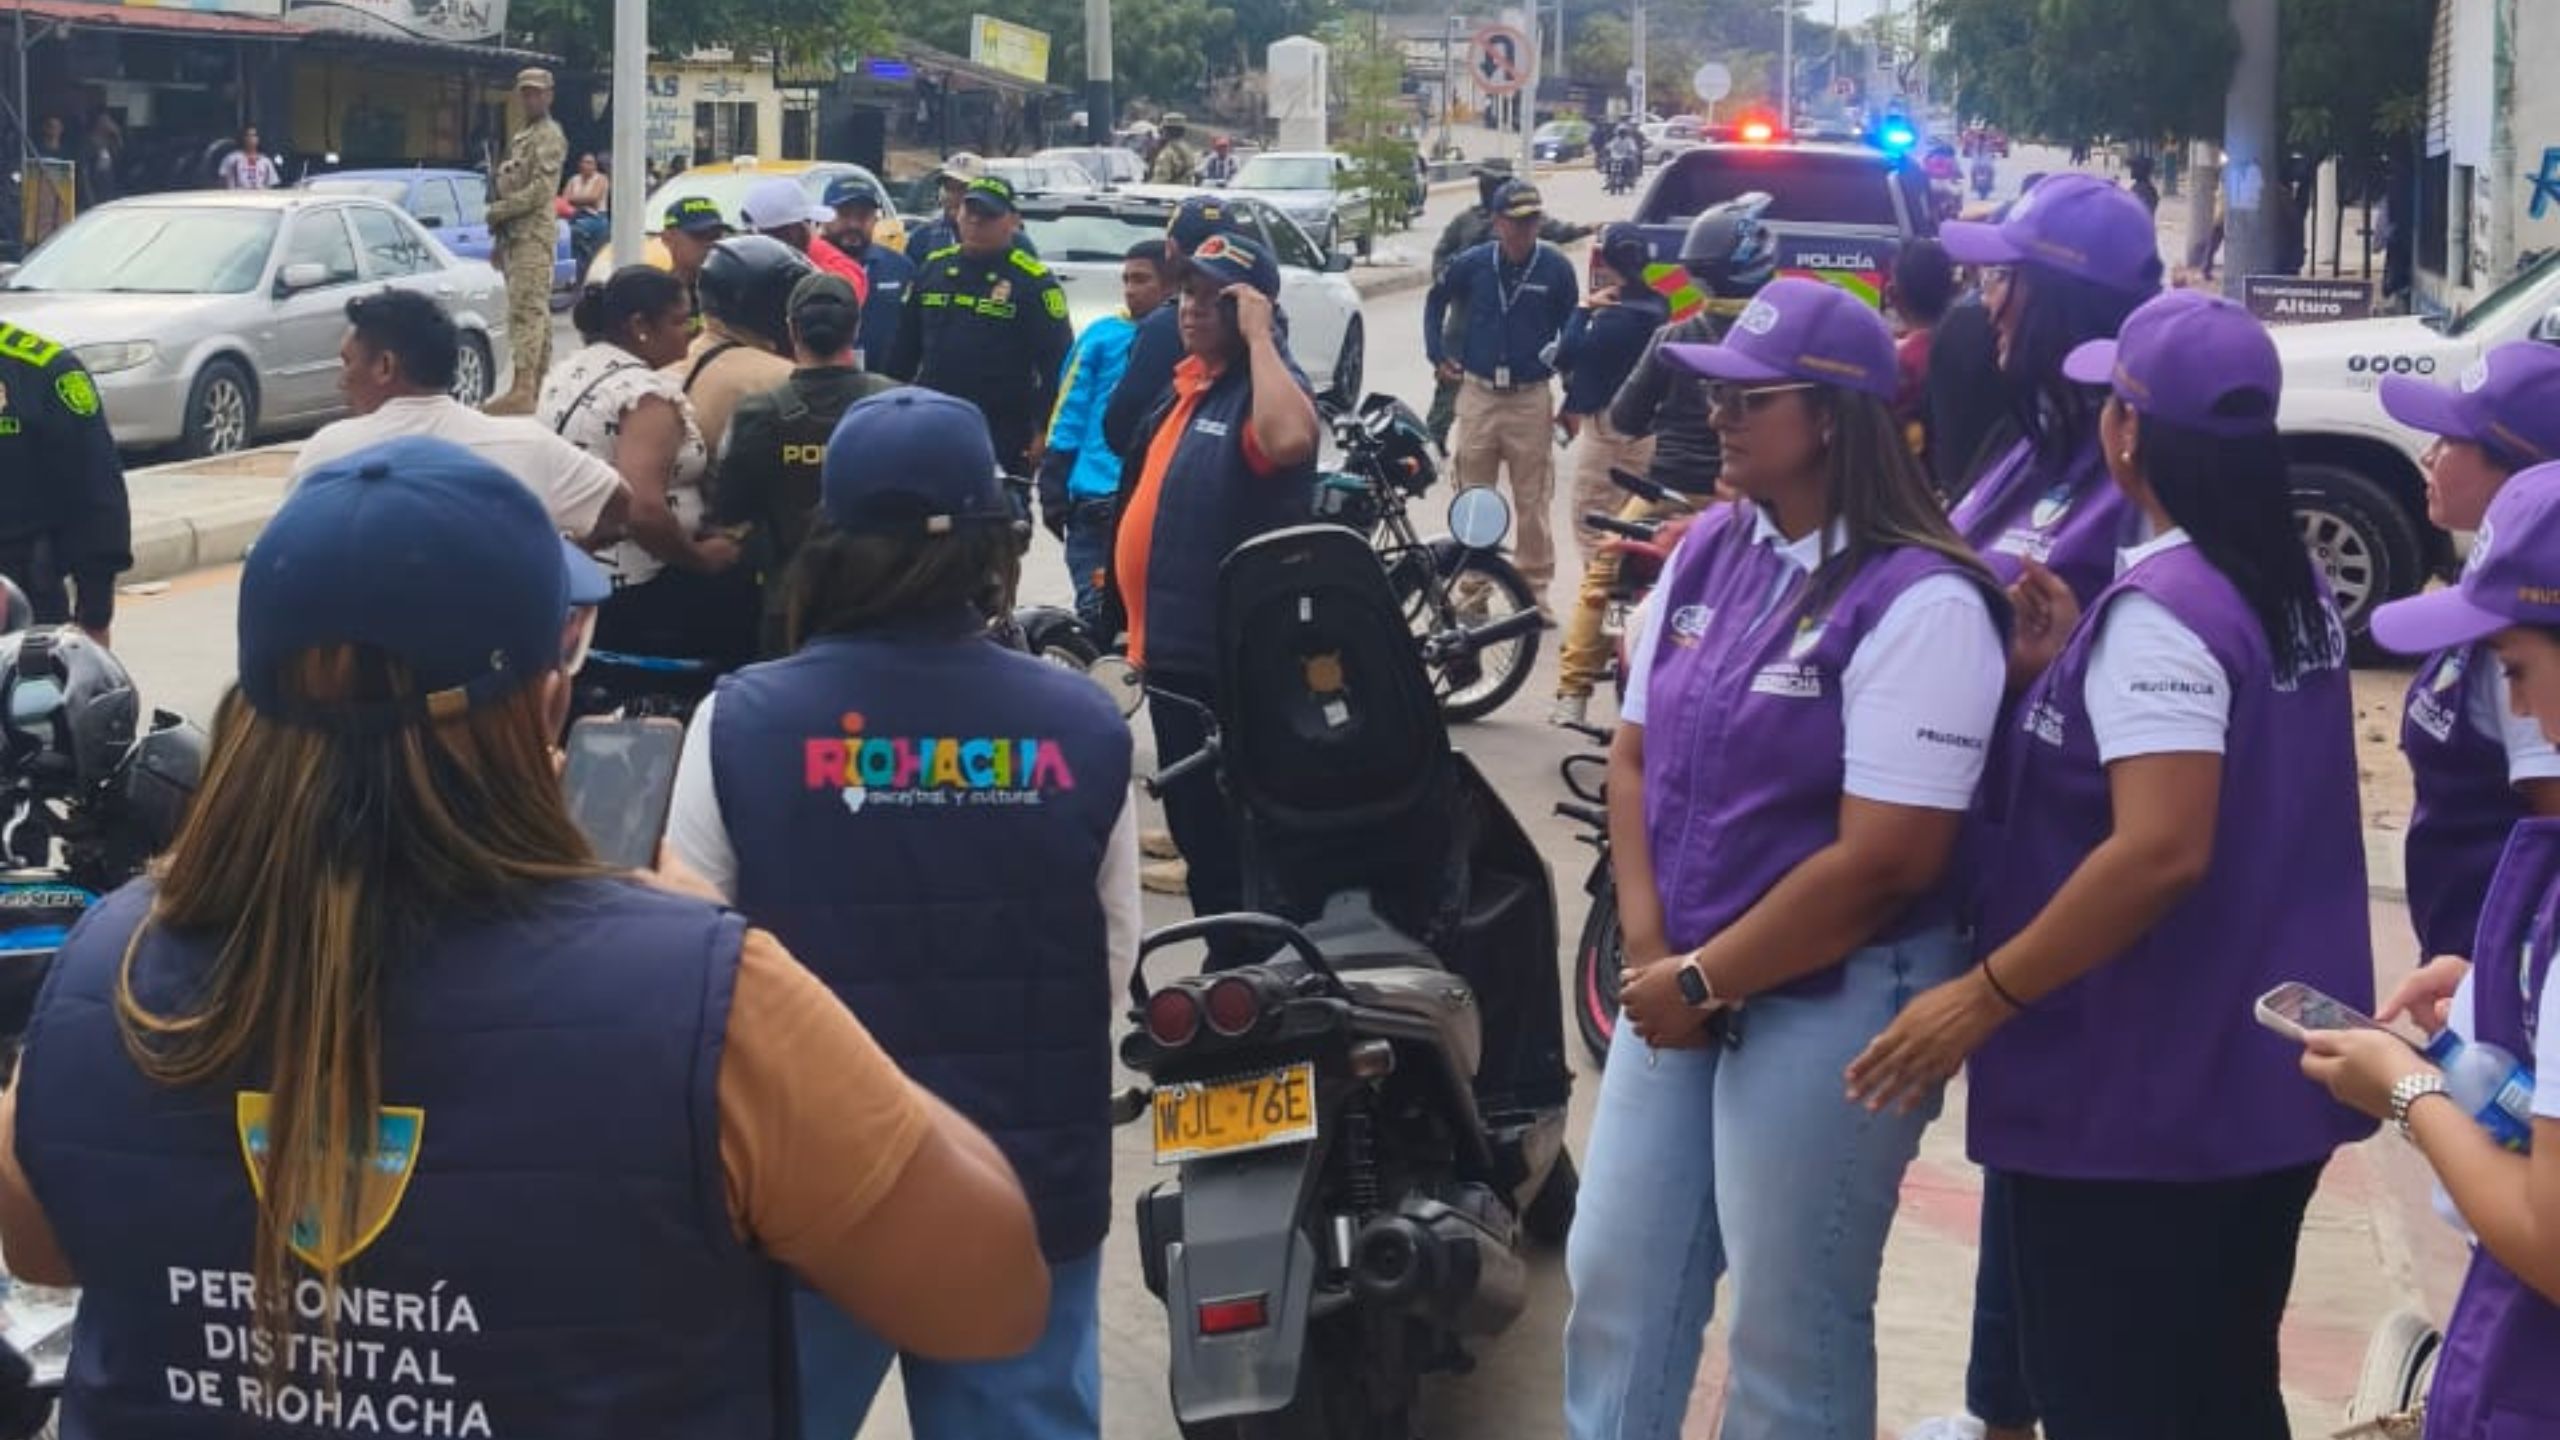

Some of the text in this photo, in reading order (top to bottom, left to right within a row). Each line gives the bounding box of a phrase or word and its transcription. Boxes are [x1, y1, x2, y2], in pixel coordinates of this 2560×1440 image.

[1796, 250, 1876, 269] POLICÍA
[167, 1266, 480, 1333] PERONERÍA
[204, 1323, 456, 1385] DISTRITAL
[166, 1367, 493, 1439] DE RIOHACHA
